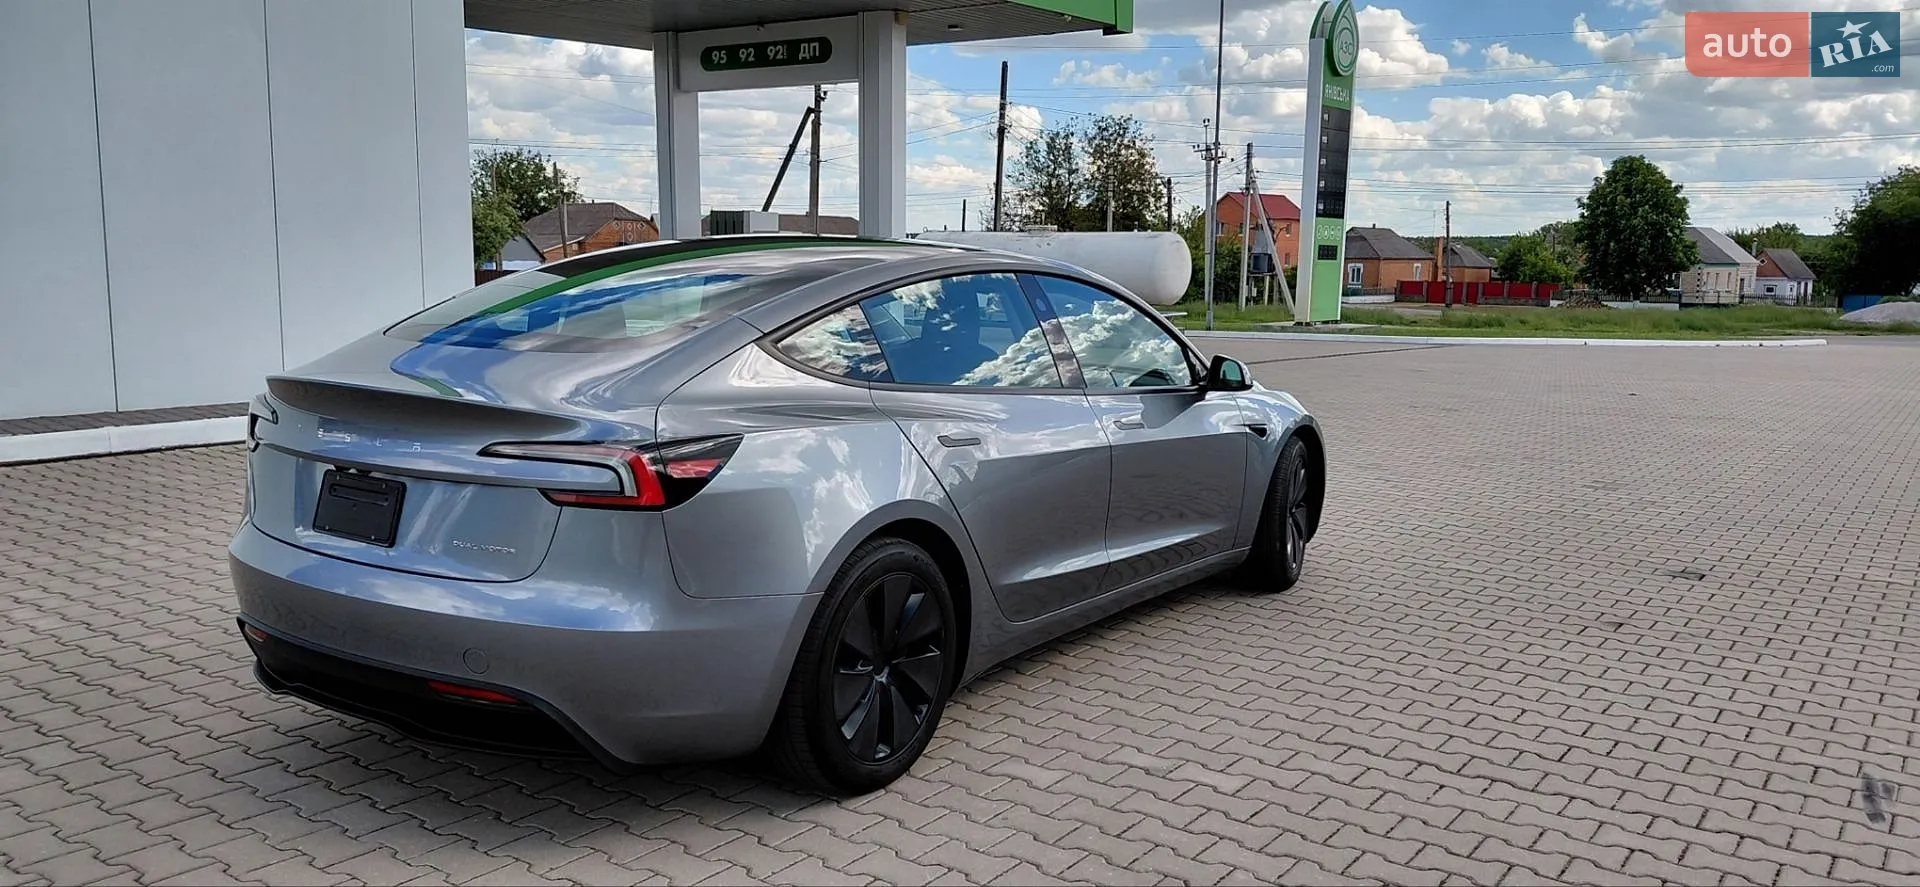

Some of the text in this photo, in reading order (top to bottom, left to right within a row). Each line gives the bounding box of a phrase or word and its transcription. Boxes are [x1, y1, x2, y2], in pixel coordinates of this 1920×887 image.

[711, 50, 727, 64] 95
[739, 47, 755, 62] 92
[798, 41, 819, 60] ДП
